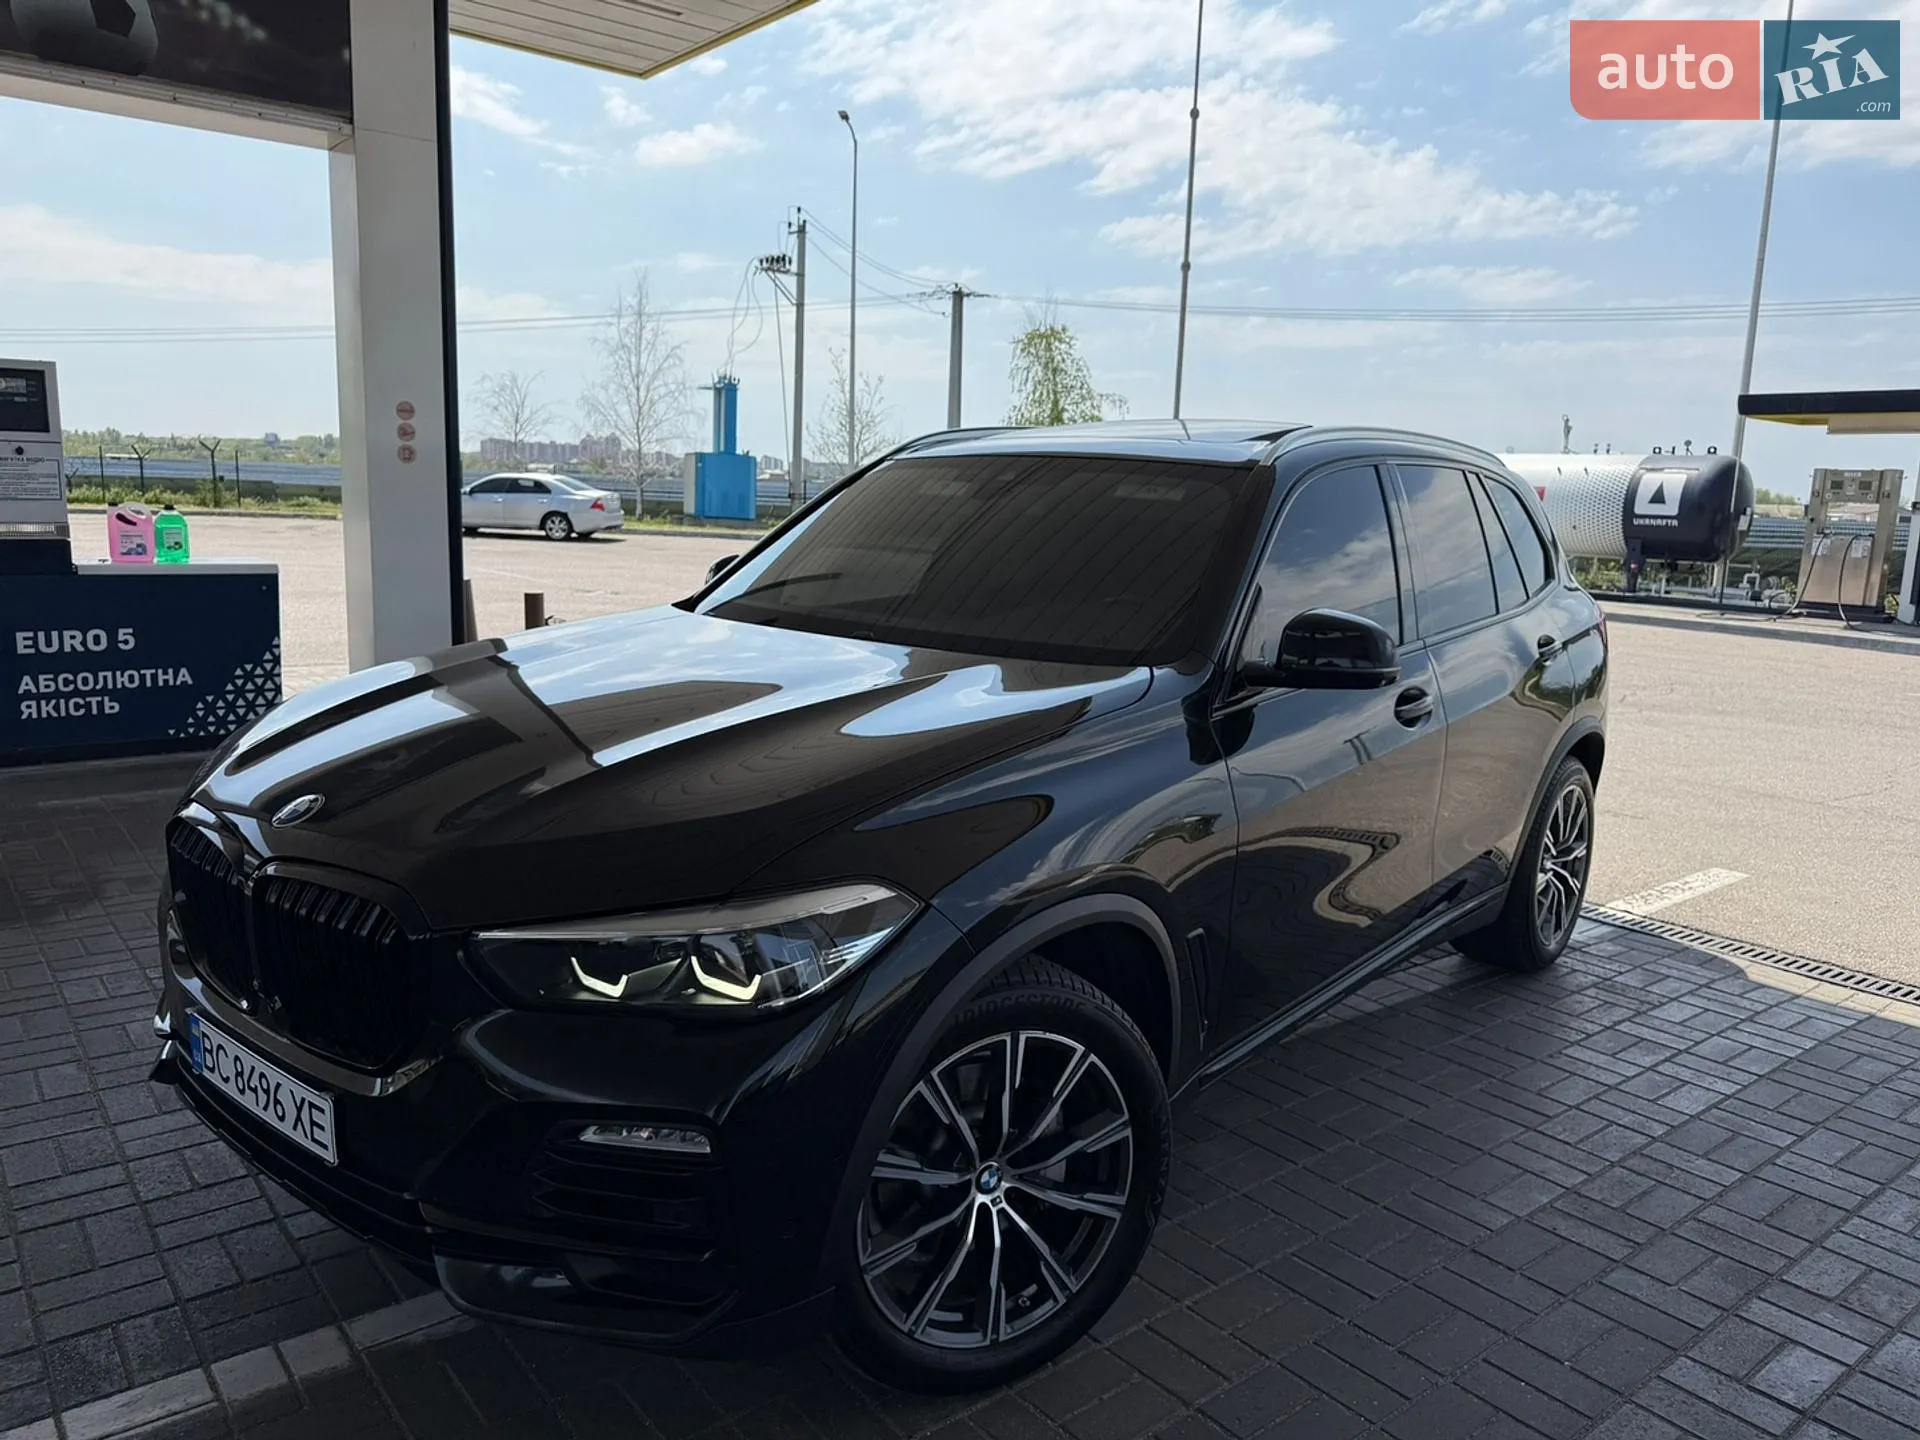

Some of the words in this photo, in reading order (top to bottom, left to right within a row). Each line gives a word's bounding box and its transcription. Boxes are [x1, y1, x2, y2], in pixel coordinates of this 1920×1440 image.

[15, 628, 108, 654] EURO
[117, 628, 136, 651] 5
[18, 667, 193, 694] АБСОЛЮТНА
[20, 696, 120, 720] ЯКІСТЬ
[201, 1030, 231, 1084] BC
[233, 1054, 287, 1122] 8496
[290, 1088, 329, 1152] XE
